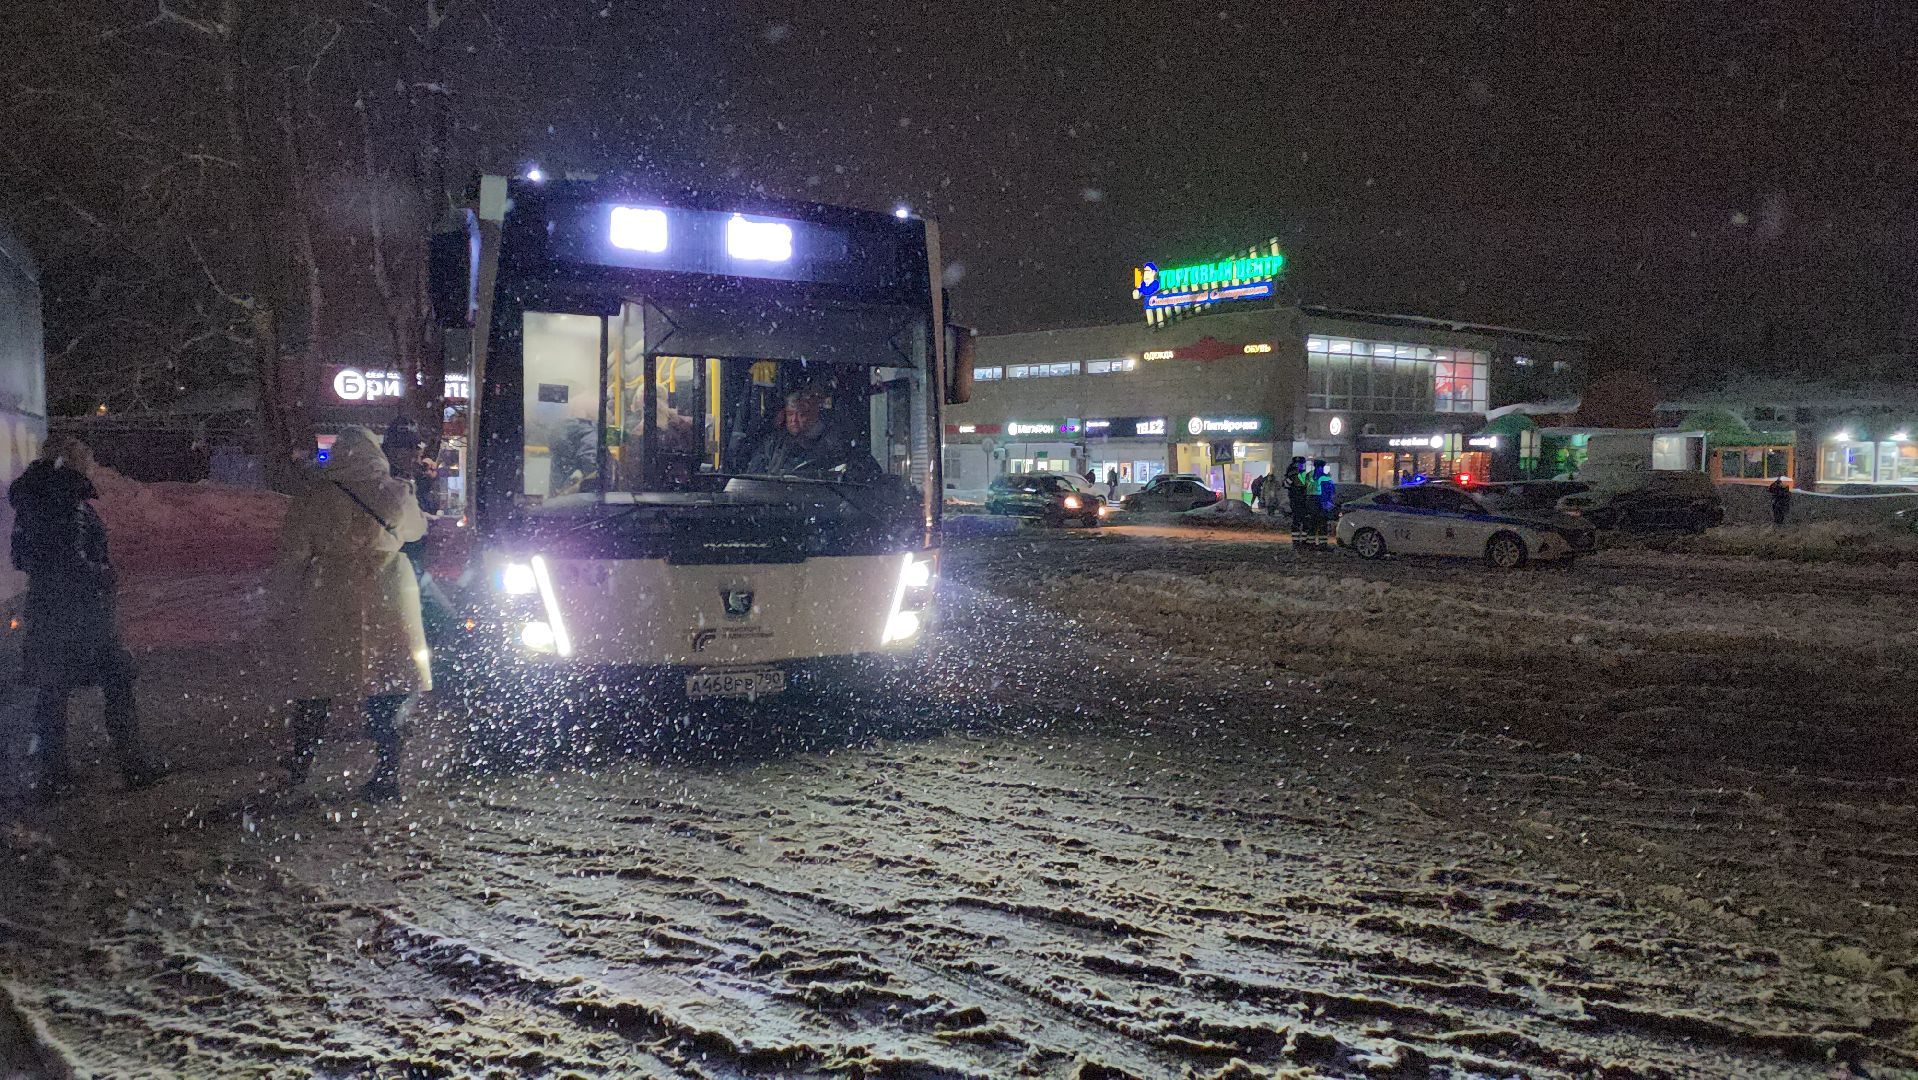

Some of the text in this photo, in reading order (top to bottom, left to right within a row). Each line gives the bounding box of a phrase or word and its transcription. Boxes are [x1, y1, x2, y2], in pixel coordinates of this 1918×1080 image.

[1159, 255, 1284, 290] ТОРГОВЫЙ ЦЕНТР
[1143, 350, 1174, 361] ОДЕЖДА
[1243, 343, 1272, 354] ОБУВЬ
[1136, 419, 1165, 435] TELE2
[1203, 419, 1259, 433] Пятёрочка
[757, 672, 781, 686] 790
